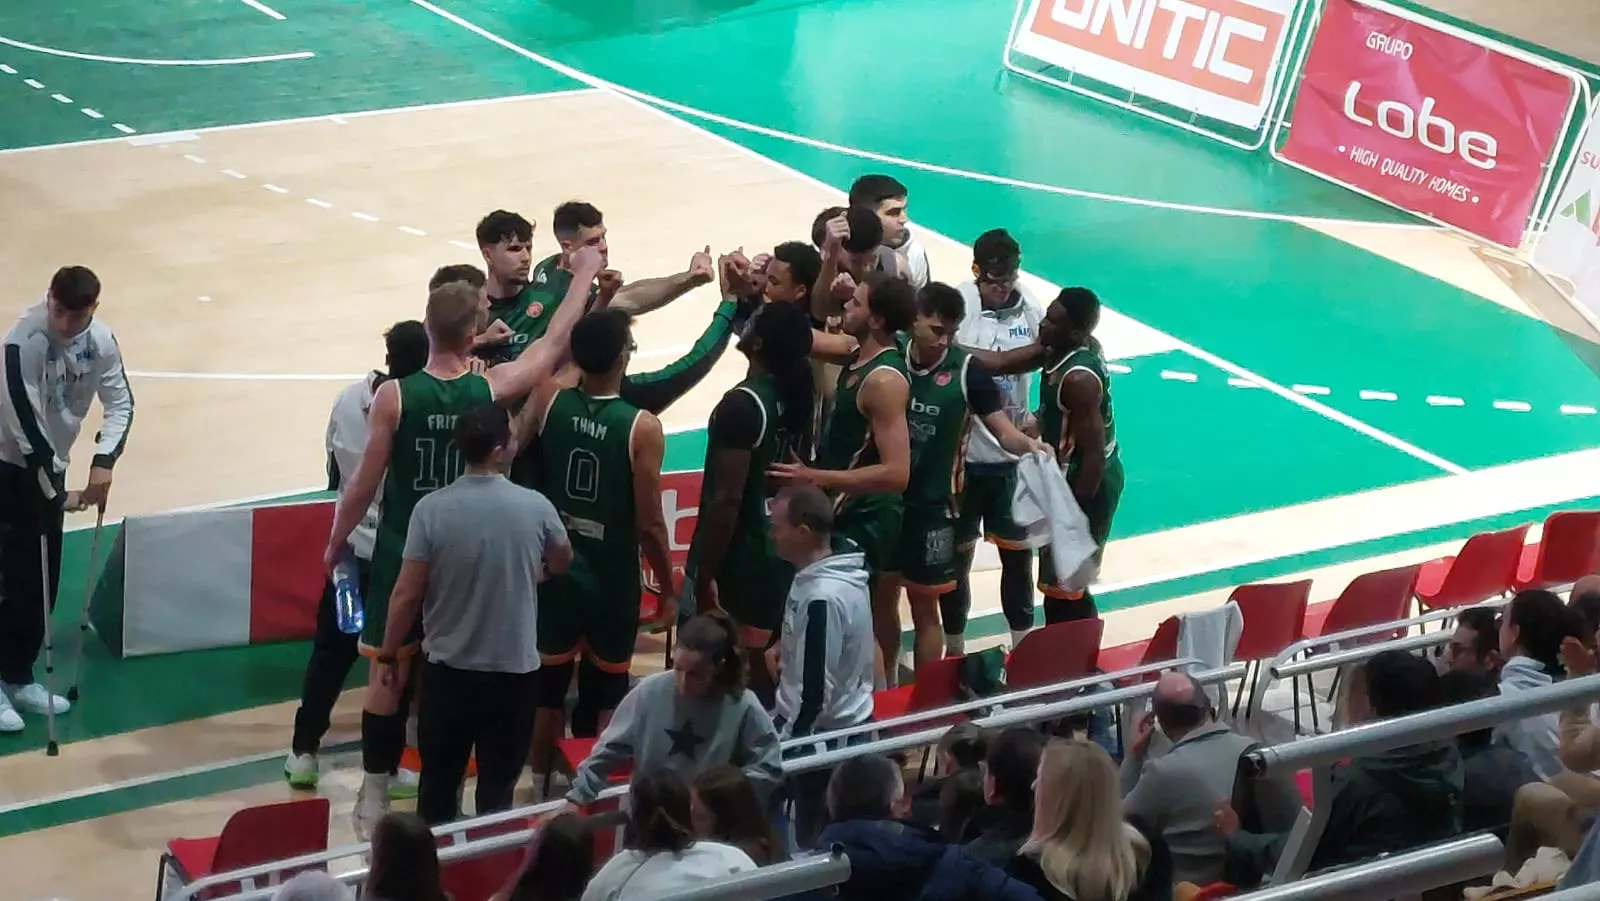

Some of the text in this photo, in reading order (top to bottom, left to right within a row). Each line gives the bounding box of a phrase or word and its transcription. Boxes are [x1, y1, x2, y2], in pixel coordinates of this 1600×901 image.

[1366, 31, 1414, 60] GRUPO
[1343, 80, 1498, 170] Lobe
[1350, 145, 1471, 203] HIGH QUALITY HOMES
[1580, 151, 1600, 171] SU
[427, 414, 458, 430] FRIT
[565, 447, 600, 504] 0
